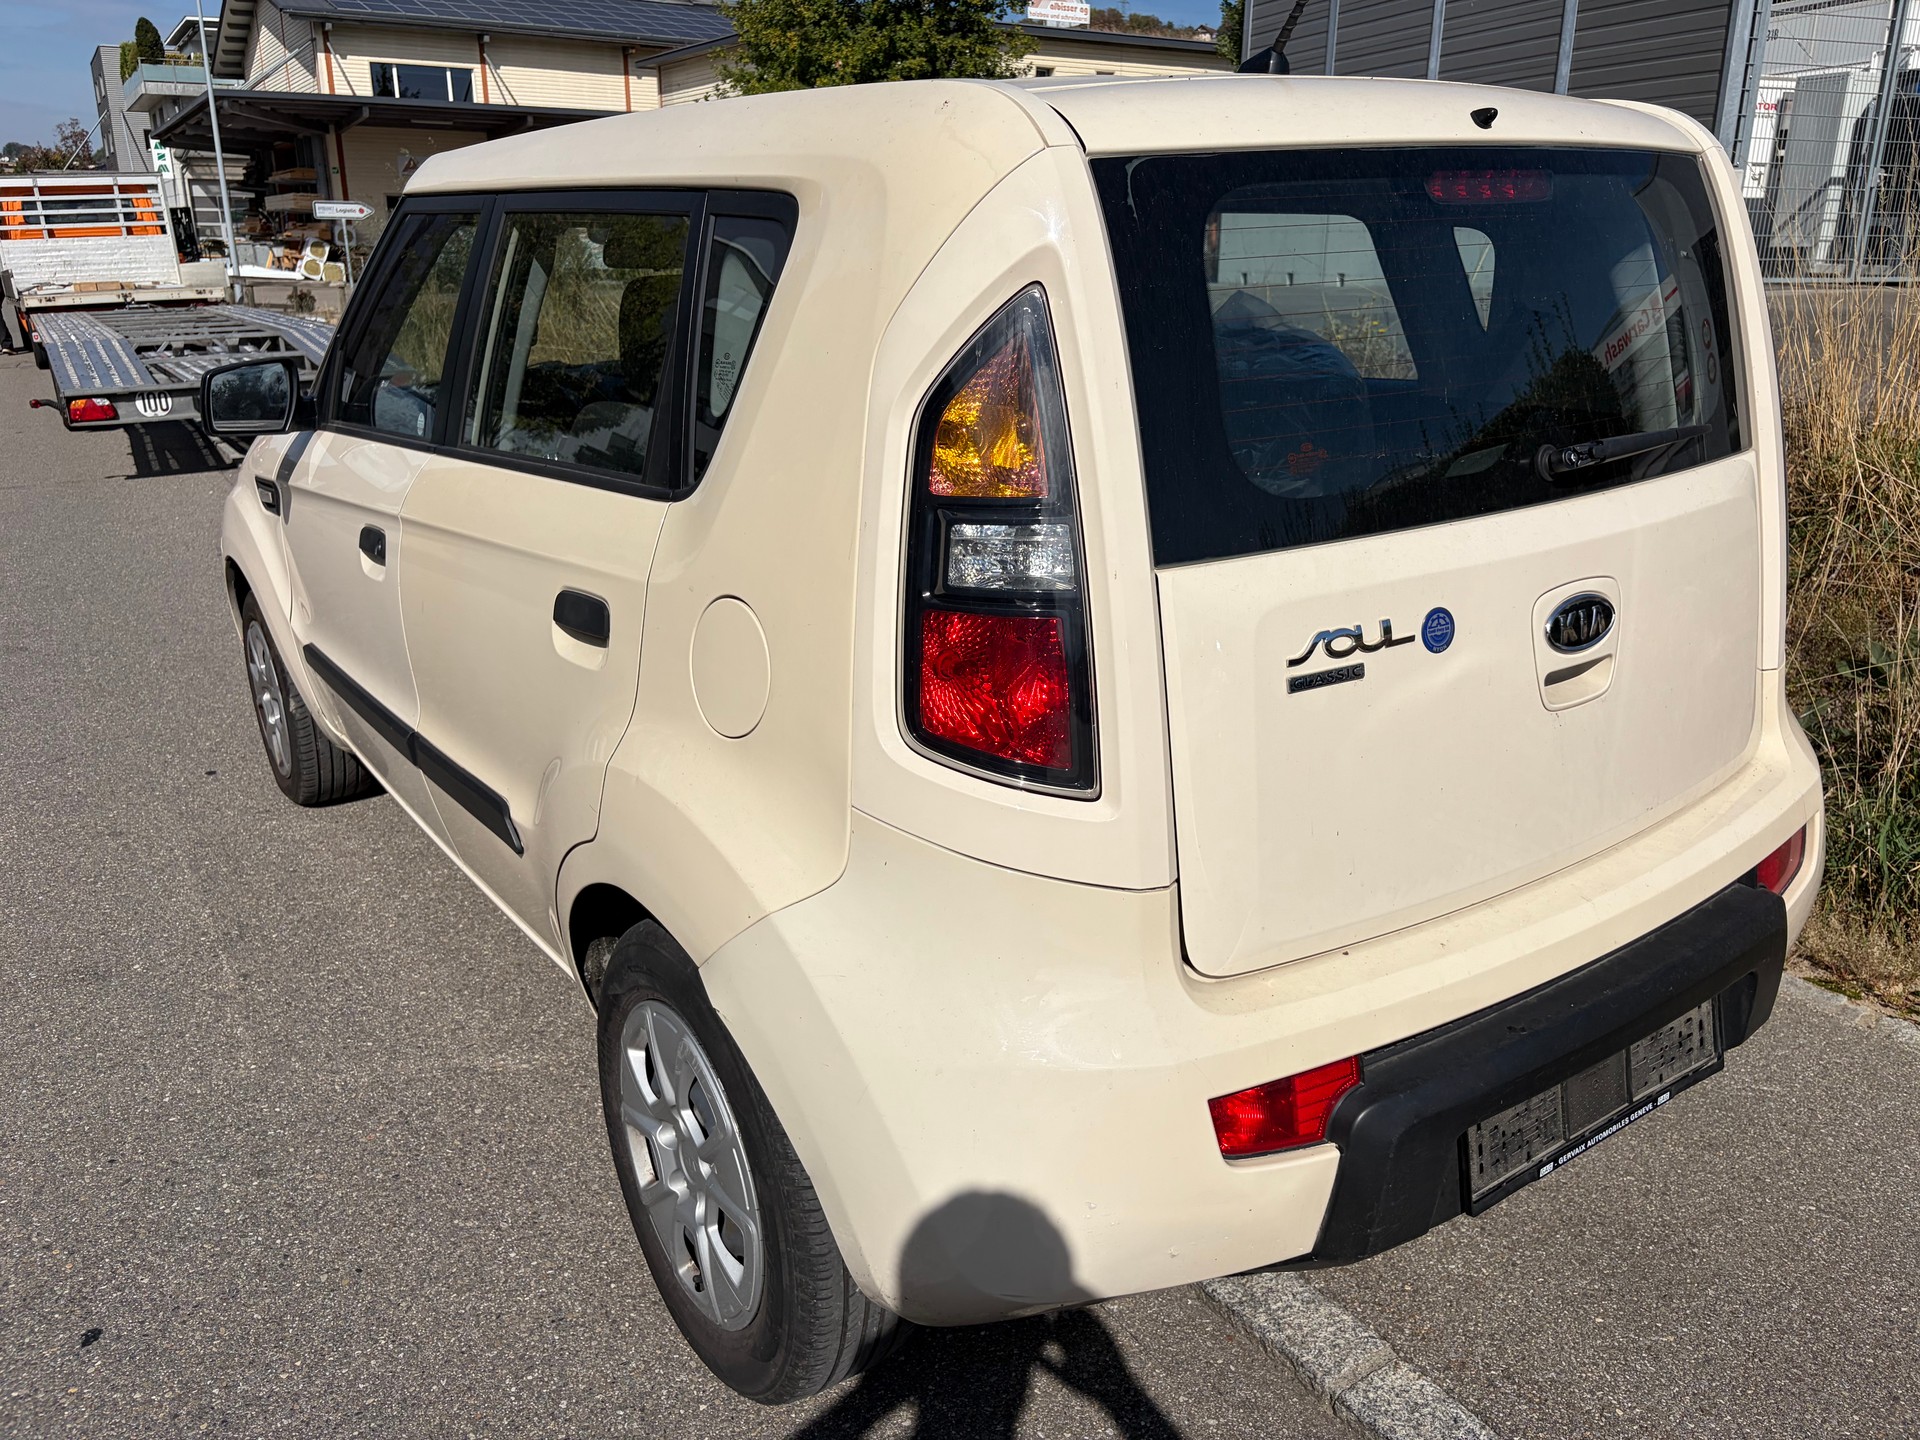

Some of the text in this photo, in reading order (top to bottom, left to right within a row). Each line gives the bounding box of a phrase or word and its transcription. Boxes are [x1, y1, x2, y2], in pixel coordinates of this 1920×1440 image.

[138, 391, 170, 413] 100
[1286, 618, 1416, 668] SOUL
[1559, 605, 1606, 645] KIA
[1292, 665, 1363, 690] CLASSIC
[1558, 1144, 1586, 1165] GERVAIX
[1586, 1116, 1630, 1148] AUTOMOBILES
[1630, 1102, 1654, 1121] GENEVE
